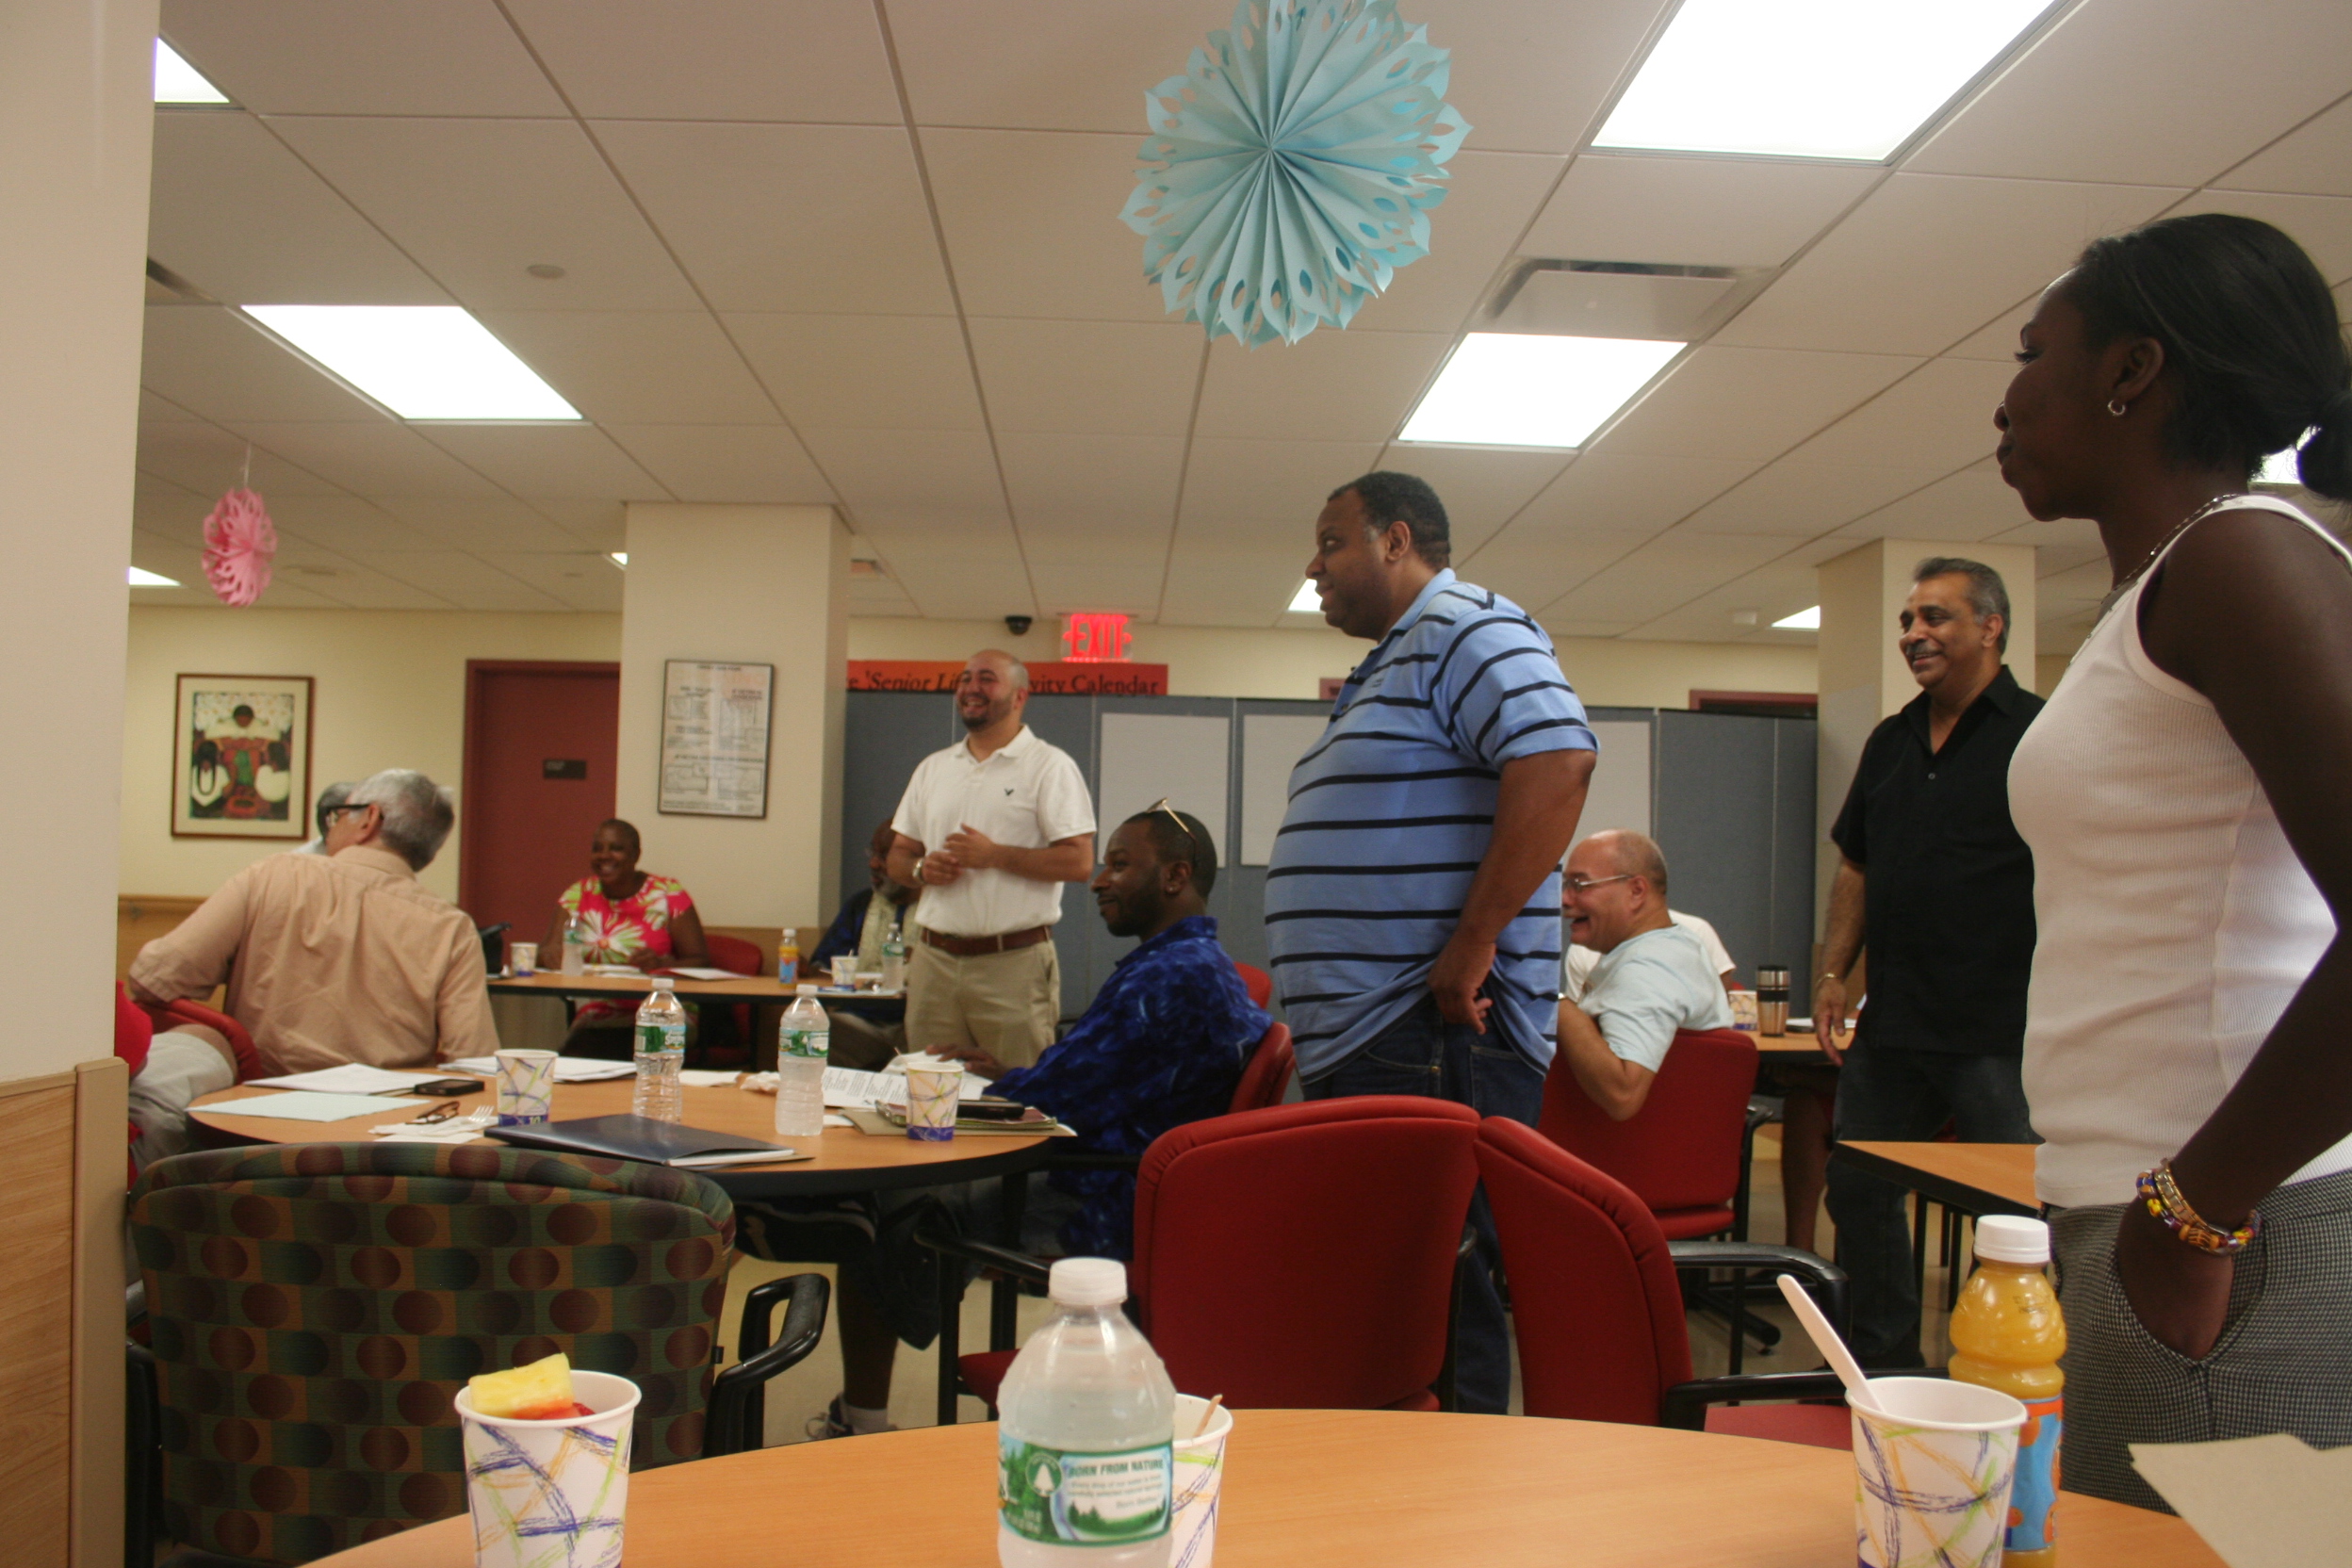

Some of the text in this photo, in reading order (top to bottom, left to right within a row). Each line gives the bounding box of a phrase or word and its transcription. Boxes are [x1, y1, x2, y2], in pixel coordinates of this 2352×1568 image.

[1070, 613, 1129, 658] EXIT
[937, 671, 962, 691] Lif
[1071, 674, 1159, 695] Calendar
[1069, 1460, 1164, 1478] BORN FROM NATURE
